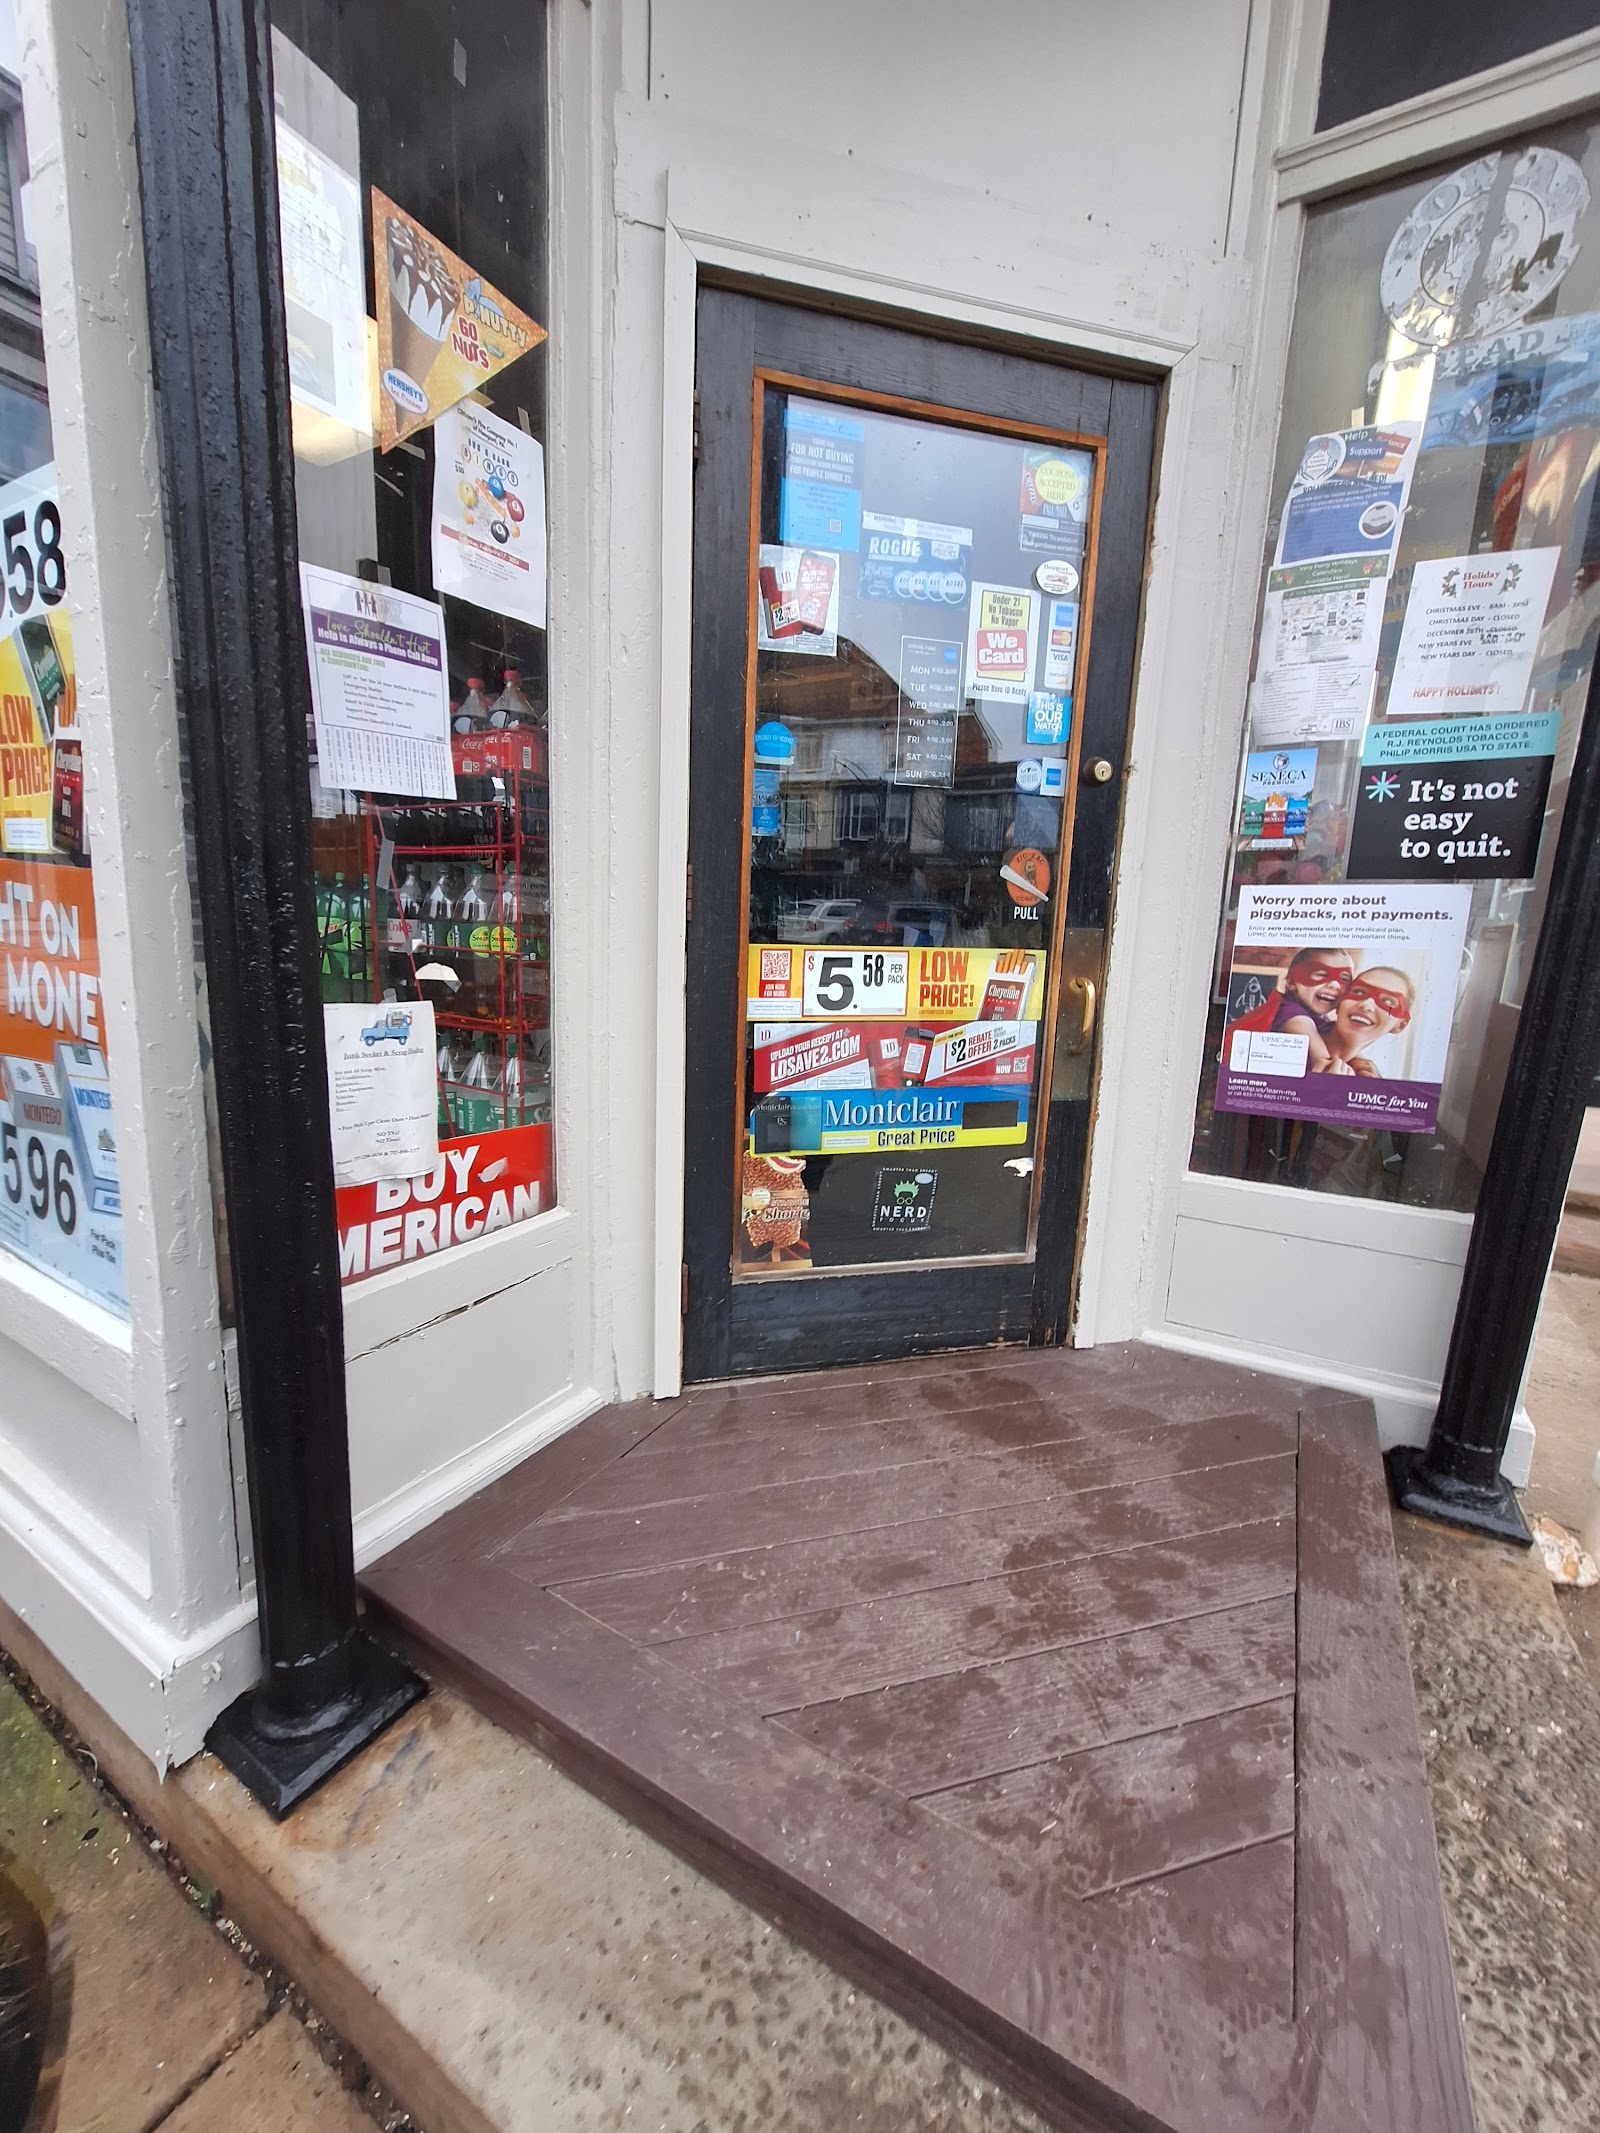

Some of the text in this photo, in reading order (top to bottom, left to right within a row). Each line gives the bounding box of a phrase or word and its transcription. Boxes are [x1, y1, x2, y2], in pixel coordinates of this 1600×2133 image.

[459, 317, 478, 341] GO
[452, 333, 489, 369] NUTS
[388, 373, 424, 403] HERSHEY'S
[1345, 430, 1369, 441] Help
[791, 442, 807, 455] FOR
[808, 445, 824, 459] NOT
[825, 449, 855, 464] BUYING
[1350, 447, 1383, 457] Support
[790, 465, 844, 482] FOR PEOPLE UNDER
[1040, 467, 1076, 479] COUPONS
[1039, 479, 1077, 491] ACCEPTED
[1046, 490, 1067, 501] HERE
[869, 536, 921, 557] ROGUE
[1332, 559, 1358, 567] Holidays
[1312, 568, 1343, 577] Calendars
[1463, 570, 1501, 581] Holiday
[946, 579, 964, 588] ROGUE
[1463, 580, 1494, 590] Hours
[993, 593, 1022, 606] Under 21
[988, 604, 1024, 617] No Tobacco
[1426, 604, 1466, 615] CHRISTMAS
[1489, 602, 1506, 610] 8AM
[991, 615, 1020, 628] No Vapor
[1428, 616, 1470, 626] CHRISTMAS
[1470, 615, 1486, 623] DAY
[327, 613, 350, 632] Love
[408, 634, 432, 654] Hurt
[1426, 627, 1484, 638] DECEMBER 26TH
[317, 627, 438, 667] Help Always Phone Call Away
[986, 632, 1018, 649] We
[1436, 640, 1458, 648] YEARS
[979, 647, 1025, 665] Card
[1053, 653, 1069, 662] VISA
[1439, 651, 1460, 659] YEARS
[1485, 649, 1513, 657] CLOSED
[910, 665, 930, 675] MON
[910, 683, 926, 692] TUE
[972, 683, 1028, 697] Please Have Ready
[1413, 686, 1446, 698] HAPPY
[909, 701, 928, 710] WED
[1037, 701, 1055, 711] THIS
[908, 718, 925, 727] THU
[1034, 710, 1063, 723] OUR
[1034, 721, 1063, 732] WATCH
[1335, 719, 1351, 729] IBS
[1383, 718, 1550, 739] FEDERAL COURT HAS ORDERED
[907, 735, 920, 744] FRI
[1387, 732, 1519, 748] R.J. REYNOLDS TOBACCO
[1379, 741, 1534, 758] PHILIP MORRIS USA TO STATE:
[906, 753, 922, 762] SAT
[905, 770, 922, 779] SUN
[1251, 769, 1307, 783] SENECA
[1408, 777, 1519, 803] It's not
[1404, 812, 1474, 836] easy
[1400, 833, 1511, 864] to quit.
[1252, 895, 1387, 906] Worry more about
[1013, 906, 1039, 920] PULL
[1250, 908, 1453, 921] piggybacks, not payments.
[40, 900, 80, 962] ON
[863, 954, 885, 988] 58
[891, 963, 903, 974] PER
[920, 951, 970, 982] LOW
[888, 974, 905, 984] PACK
[8, 952, 103, 1043] MONE
[919, 984, 975, 1008] PRICE!
[988, 984, 1020, 1000] Cheyenne
[770, 1033, 836, 1062] UPLOAD YOUR RECEIPT
[951, 1038, 967, 1063] $2
[968, 1030, 993, 1046] REBATE
[967, 1035, 1016, 1059] OFFER PACKS
[770, 1034, 861, 1082] LDSAVE2.COM
[995, 1064, 1011, 1075] NOW
[1228, 1077, 1248, 1085] Learn
[1347, 1091, 1429, 1110] UPMC for You
[23, 1103, 61, 1126] MONTEGO
[824, 1095, 961, 1128] Montclair
[877, 1130, 915, 1147] Great
[919, 1129, 955, 1145] Price
[880, 1205, 927, 1218] NERD
